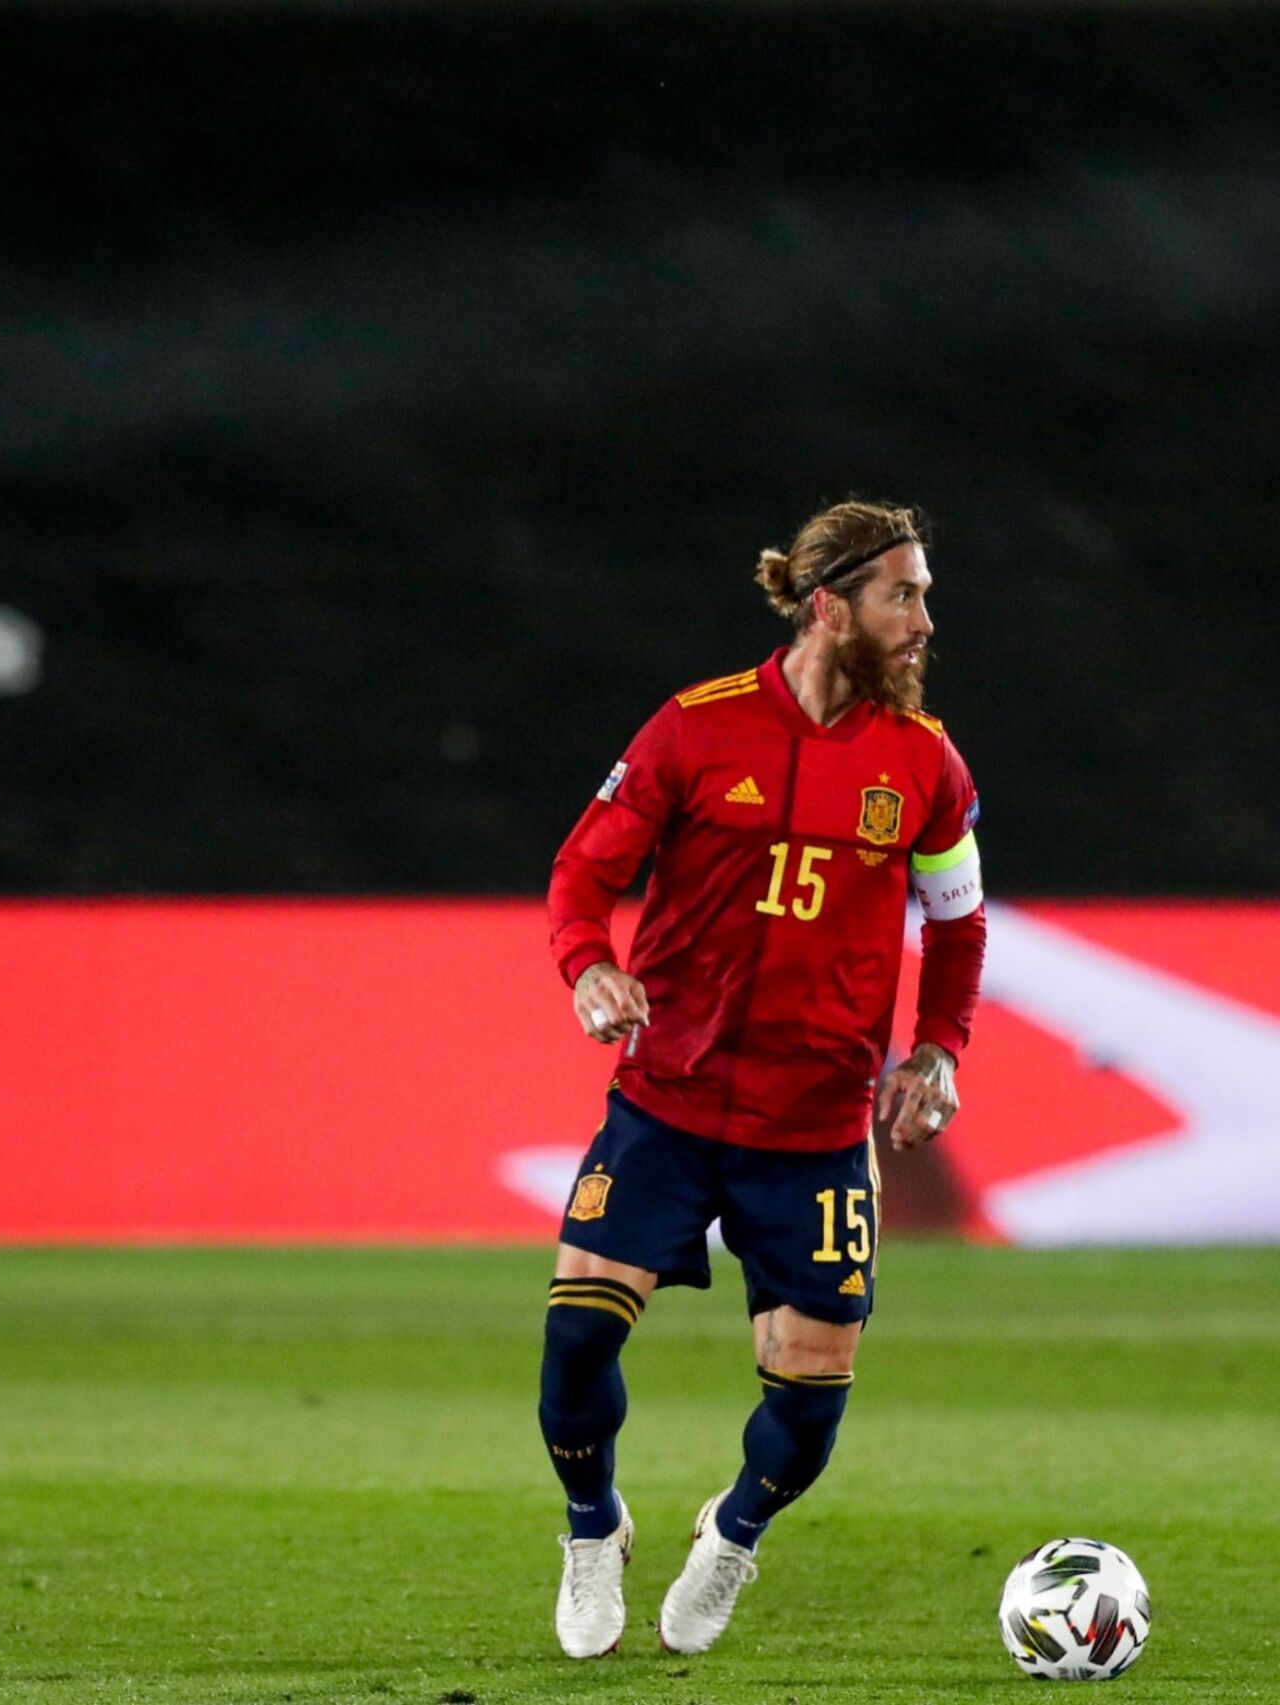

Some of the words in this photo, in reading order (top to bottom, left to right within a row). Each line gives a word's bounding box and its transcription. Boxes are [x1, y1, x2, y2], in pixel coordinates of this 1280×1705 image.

[724, 792, 765, 805] adidas
[755, 842, 833, 921] 15
[813, 1188, 871, 1263] 15
